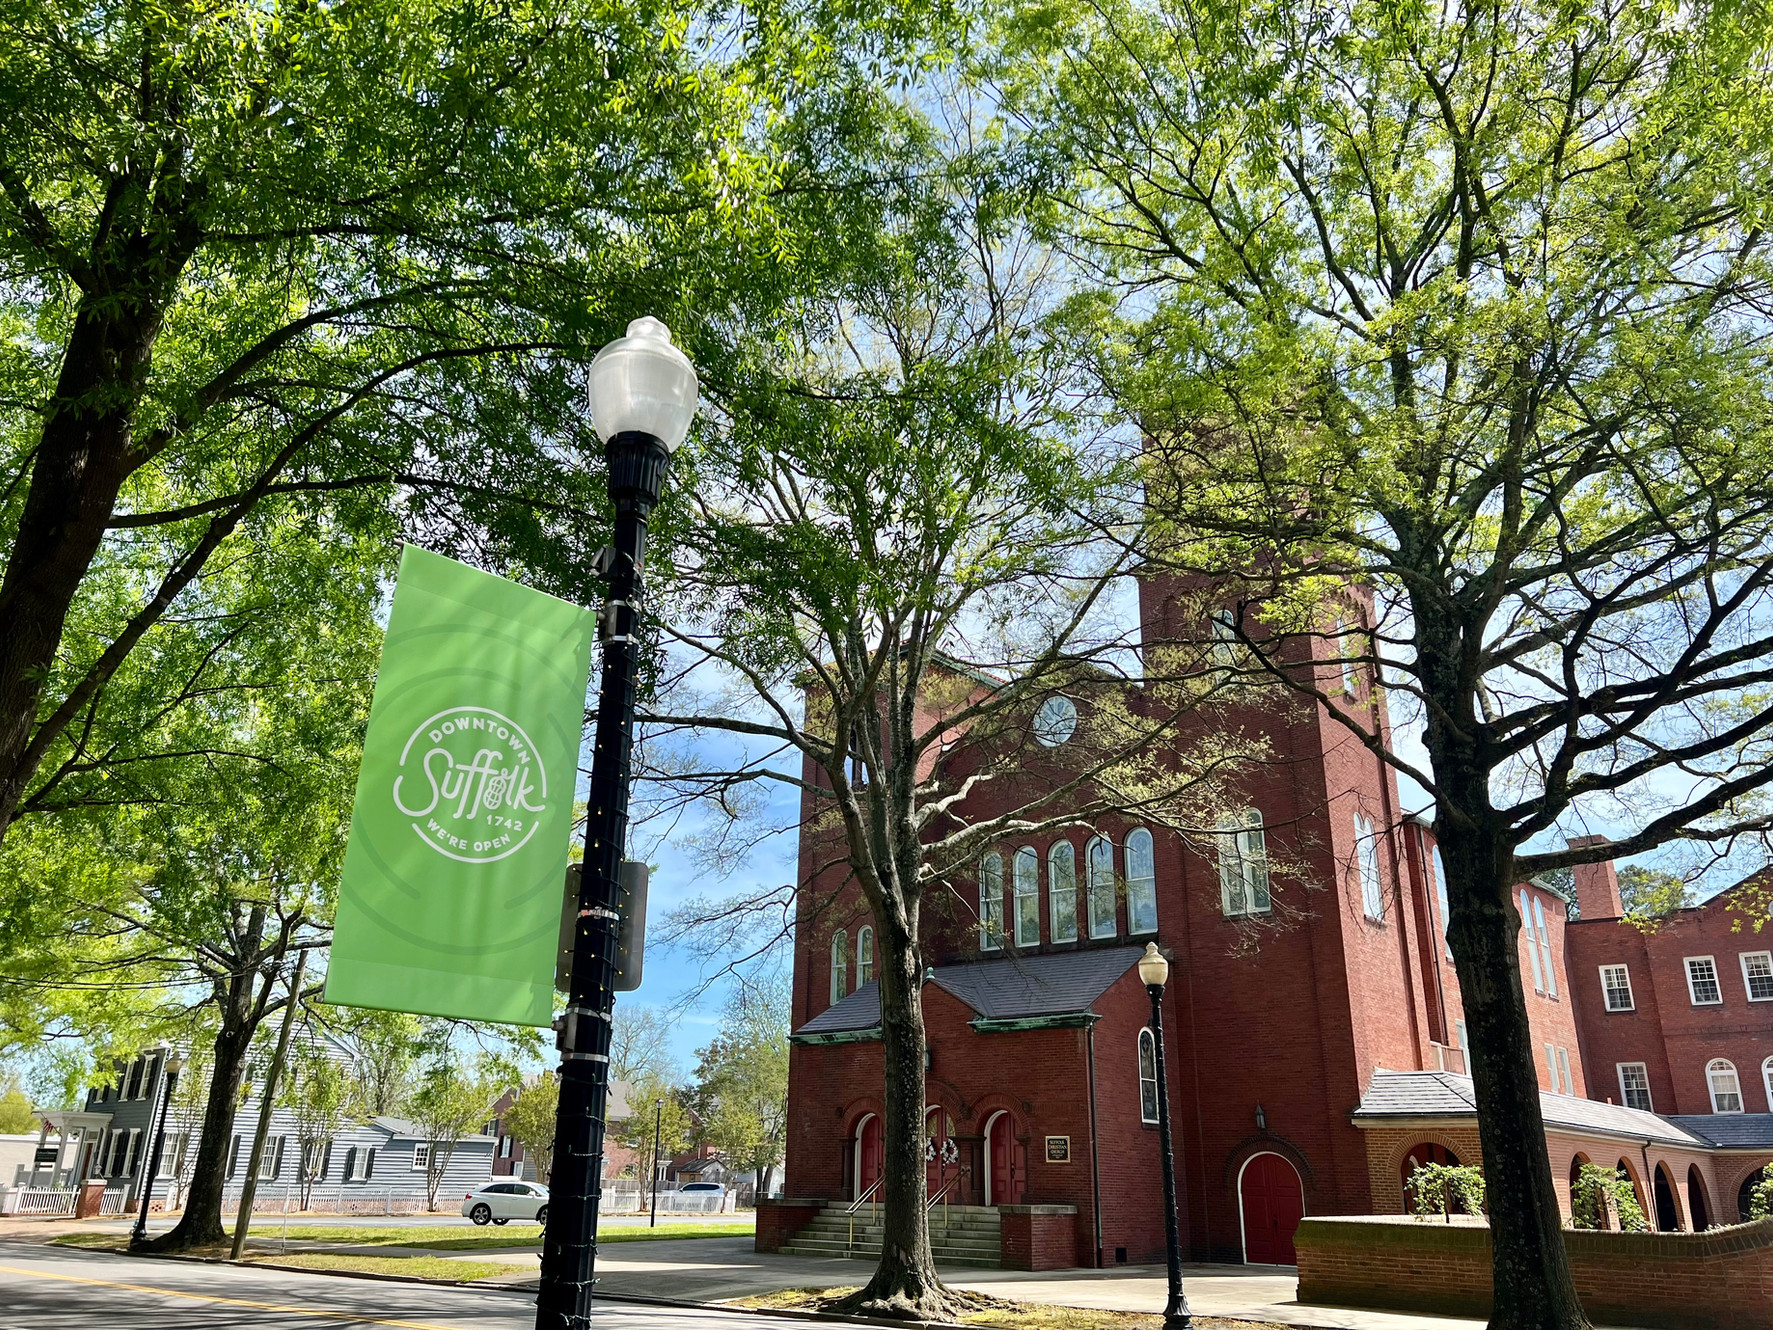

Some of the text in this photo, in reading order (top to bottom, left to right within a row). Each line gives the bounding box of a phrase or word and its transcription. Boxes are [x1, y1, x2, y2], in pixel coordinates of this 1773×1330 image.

[428, 717, 531, 765] DOWNTOWN
[393, 748, 546, 820] Suffolk
[426, 818, 511, 852] WE'RE OPEN
[486, 815, 523, 831] 1742
